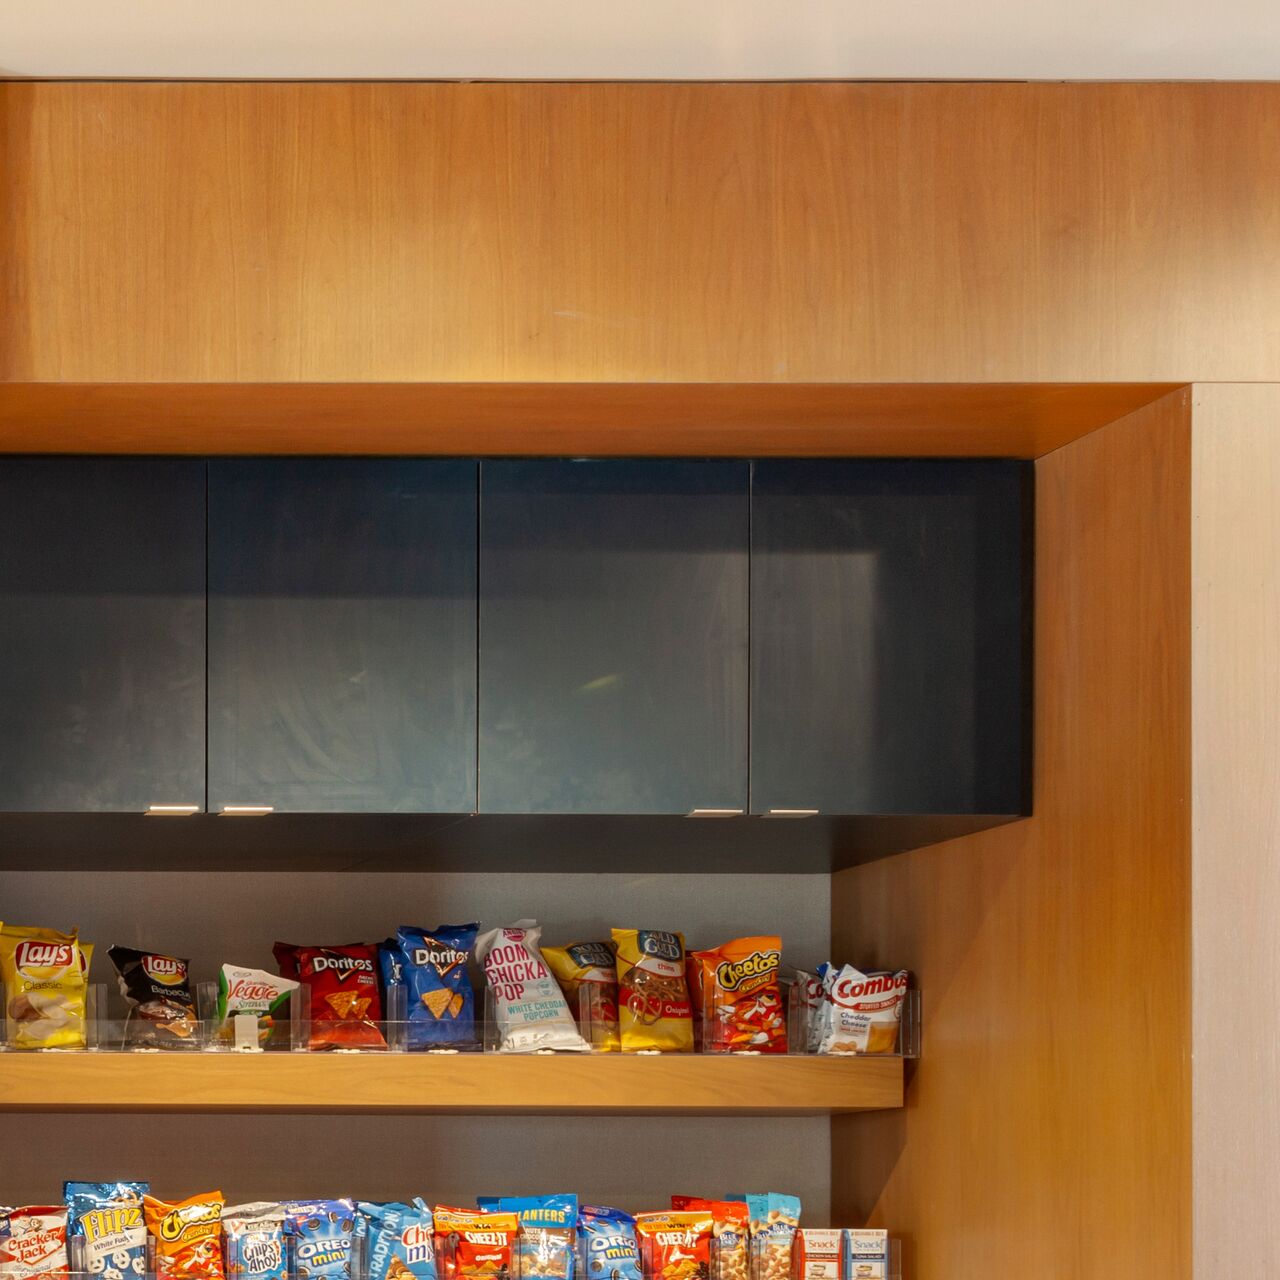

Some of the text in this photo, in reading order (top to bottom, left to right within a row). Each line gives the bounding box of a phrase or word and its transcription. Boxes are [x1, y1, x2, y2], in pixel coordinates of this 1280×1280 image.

[19, 942, 71, 967] Lay's
[483, 944, 529, 968] BOOM
[313, 956, 373, 973] Doritos
[486, 961, 549, 985] CHICKA
[718, 952, 780, 988] Cheetos
[23, 980, 63, 992] Classic
[227, 979, 279, 1000] Veggie
[494, 983, 525, 1005] POP
[837, 973, 908, 999] Combos
[507, 1004, 532, 1014] WHITE
[523, 1010, 559, 1022] POPCORN
[840, 1011, 871, 1022] Cheddar
[81, 1207, 142, 1243] Flipz
[8, 1230, 58, 1251] Cracker
[93, 1239, 113, 1250] White
[298, 1239, 351, 1258] OREO
[809, 1239, 835, 1248] Snack
[855, 1240, 881, 1249] Snack
[16, 1246, 48, 1263] Jack
[243, 1244, 274, 1260] Chips
[312, 1248, 346, 1265] mini
